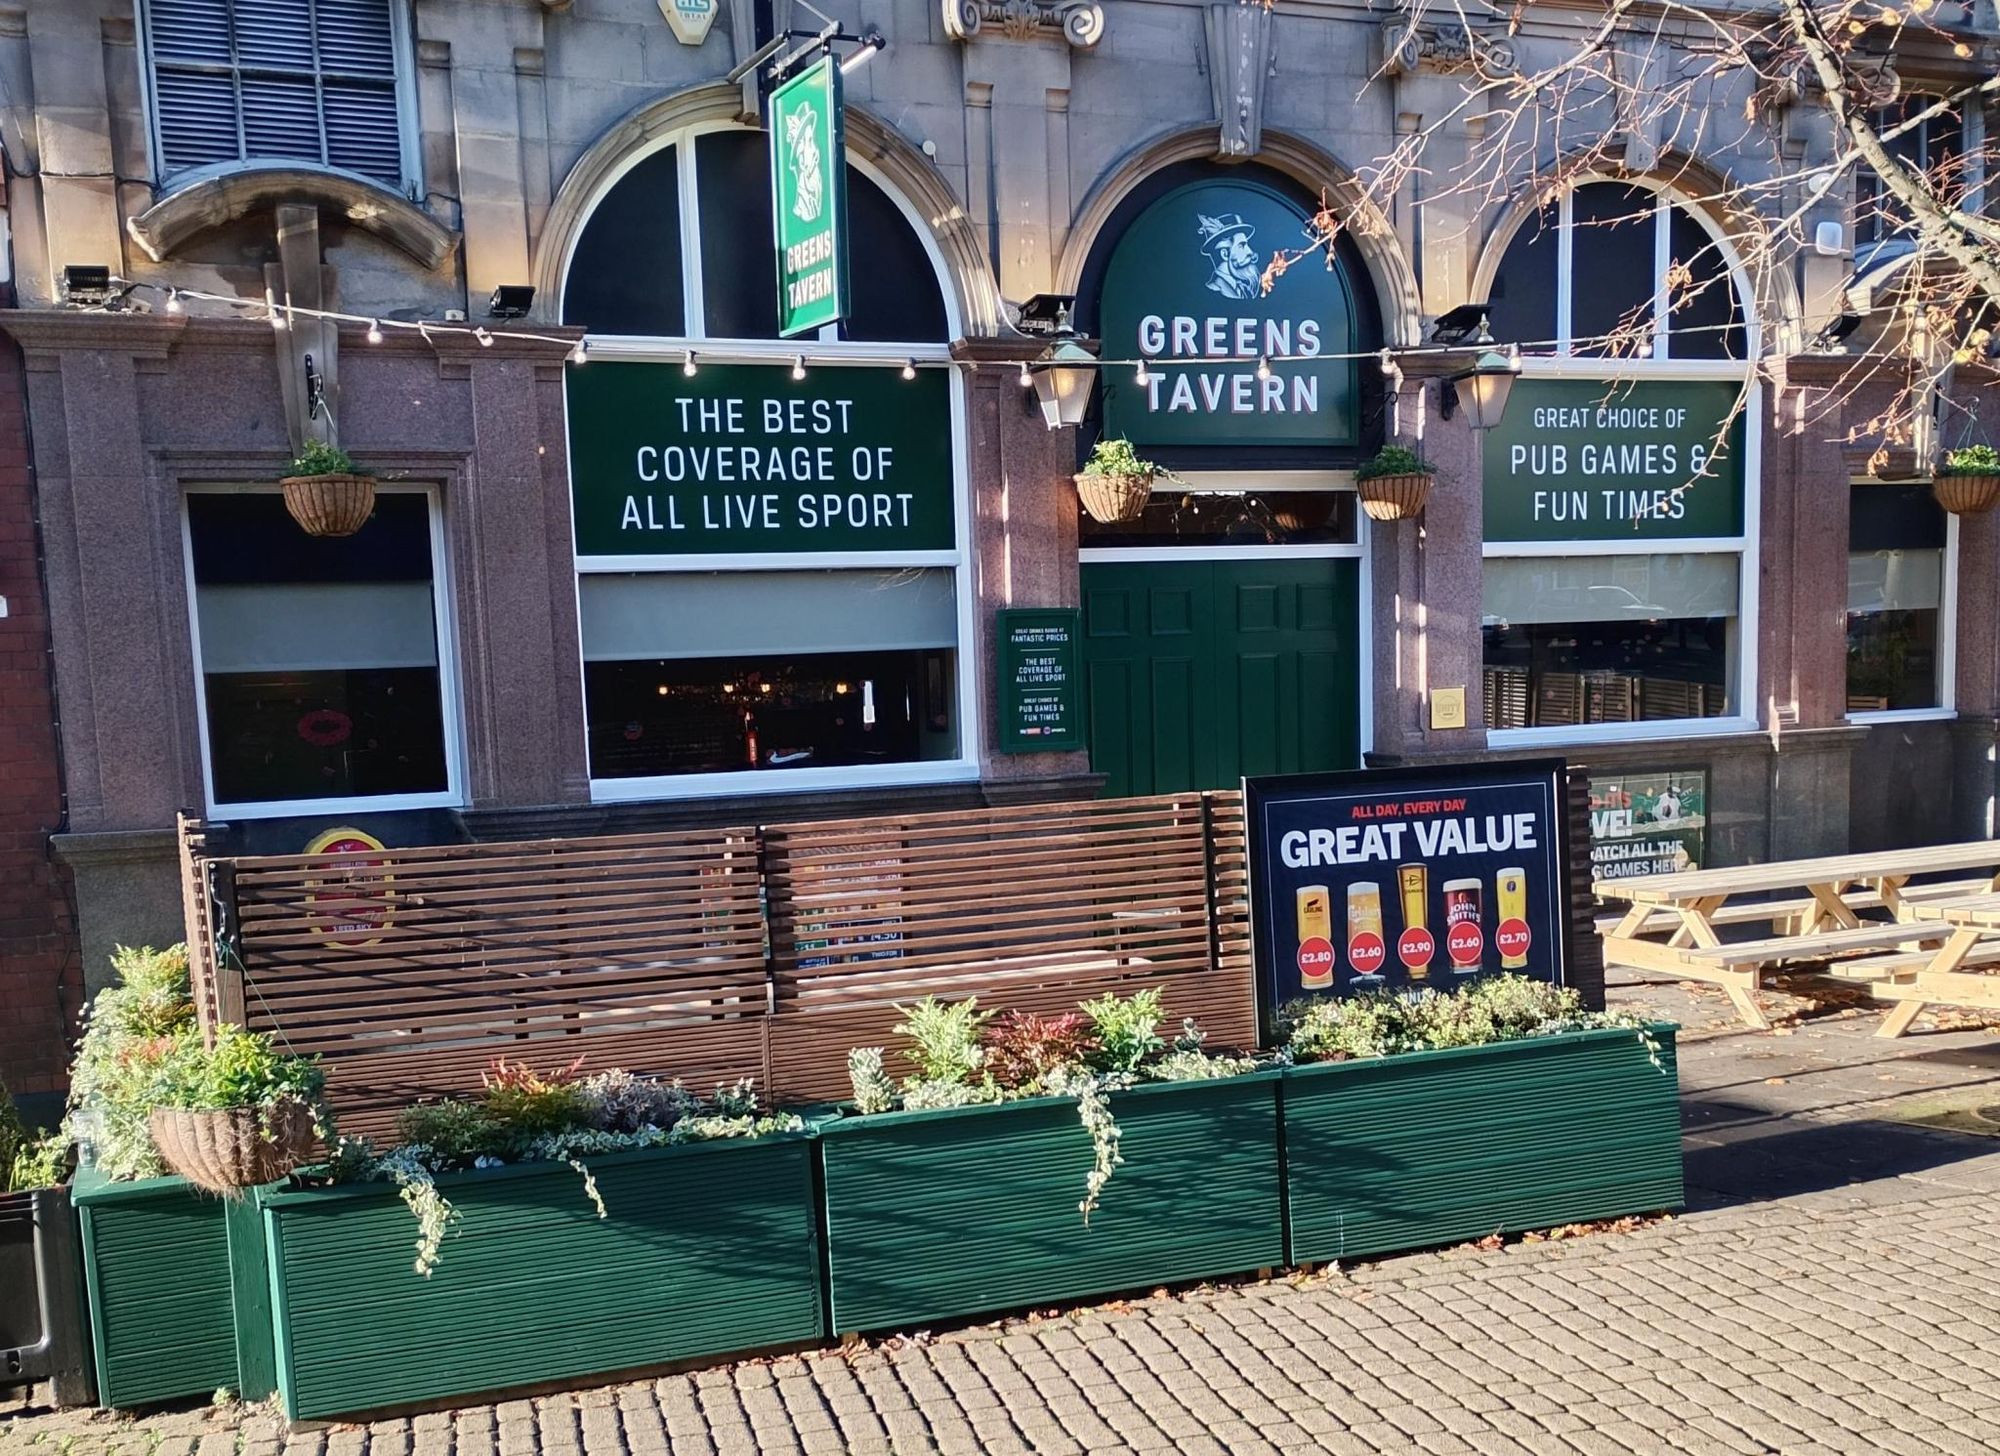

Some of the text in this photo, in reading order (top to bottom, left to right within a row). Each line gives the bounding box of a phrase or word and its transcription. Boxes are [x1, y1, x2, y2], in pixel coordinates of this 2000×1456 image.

[787, 230, 831, 275] GREENS
[788, 267, 832, 310] TAVERN
[1138, 314, 1321, 357] GREENS
[1146, 372, 1318, 414] TAVERN
[674, 398, 853, 434] THE BEST
[1533, 407, 1686, 429] GREAT CHOICE OF
[636, 445, 893, 482] COVERAGE OF
[1510, 443, 1707, 475] PUB GAMES &
[620, 493, 913, 530] ALL LIVE SPORT
[1533, 489, 1685, 521] FUN TIMES
[1011, 633, 1068, 643] FANTASTIC PRICES
[1018, 665, 1062, 674] COVERAGE OF
[1025, 657, 1056, 666] THE BEST
[1016, 673, 1066, 683] ALL LIVE SPORT
[1019, 705, 1033, 713] PUB
[1034, 704, 1058, 712] GAMES
[1024, 712, 1060, 722] FUN TIMES
[1352, 799, 1466, 819] ALL DAY, EVERY DAY
[1590, 809, 1632, 839] VE!
[1280, 812, 1538, 869] GREAT VALUE
[1590, 843, 1630, 862] ATCH
[1631, 841, 1657, 857] ALL
[1603, 861, 1650, 878] GAMES
[1449, 902, 1477, 914] JOHN
[1402, 942, 1431, 954] £2.90
[1451, 937, 1480, 949] £2.60
[1500, 932, 1528, 945] £2.70
[1301, 951, 1331, 964] £2.80
[1352, 946, 1382, 959] £2.60
